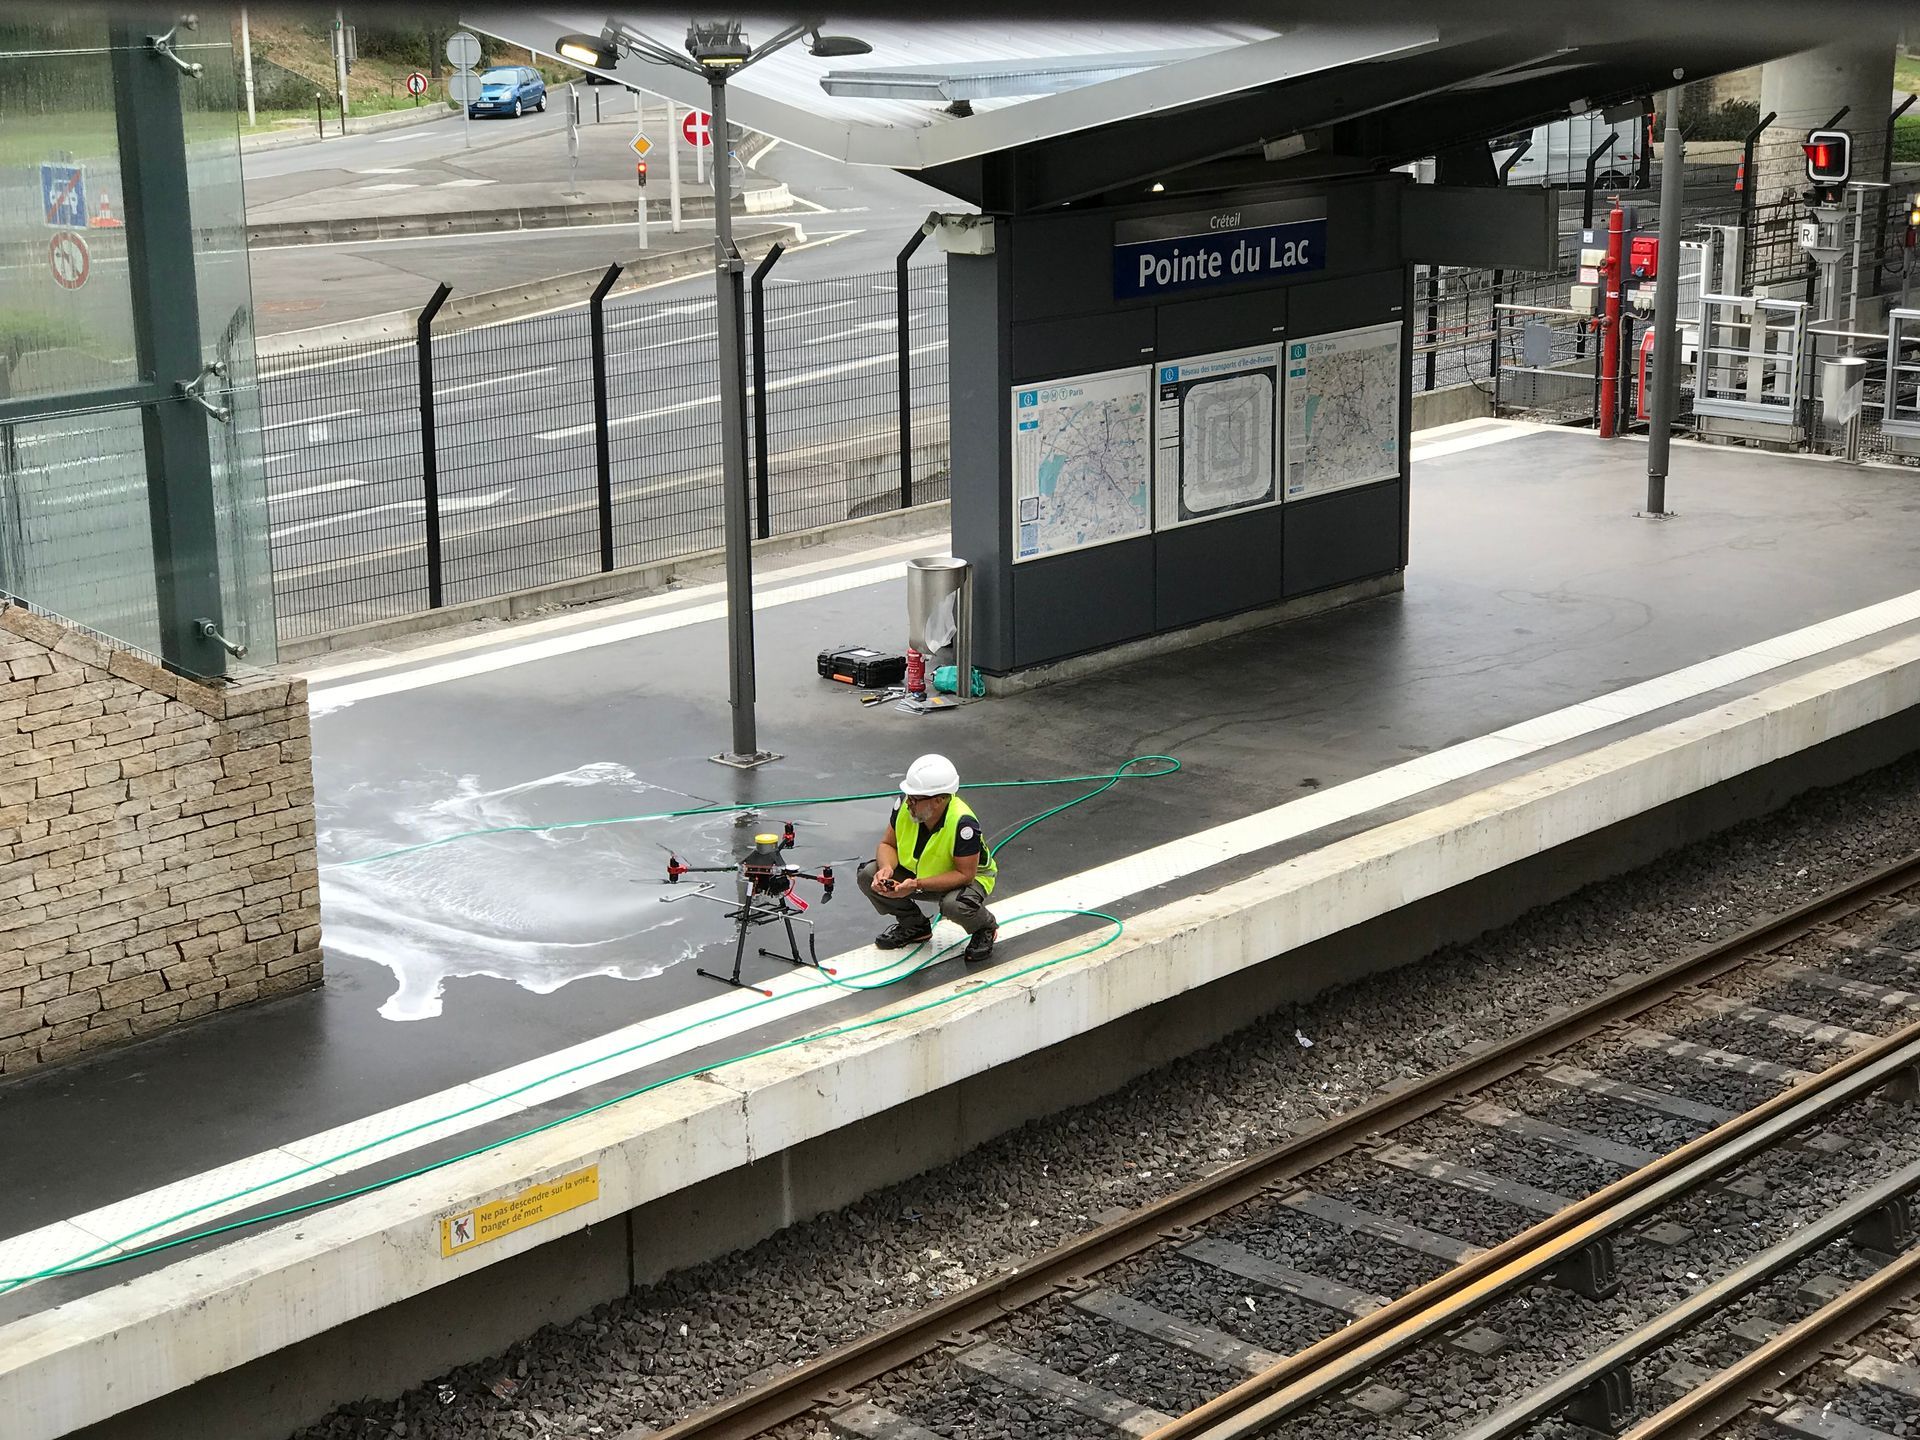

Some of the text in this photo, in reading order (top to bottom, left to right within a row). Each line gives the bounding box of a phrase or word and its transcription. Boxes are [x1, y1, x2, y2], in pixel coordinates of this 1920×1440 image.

[1210, 212, 1241, 229] Créteil
[1139, 237, 1309, 287] Pointe du Lac
[1181, 367, 1200, 376] Réseau
[1200, 365, 1209, 374] des
[1210, 361, 1237, 371] transports
[1069, 389, 1084, 397] Paris
[480, 1175, 590, 1222] Ne pas descendre sur la voie
[481, 1205, 543, 1234] Danger de mort
